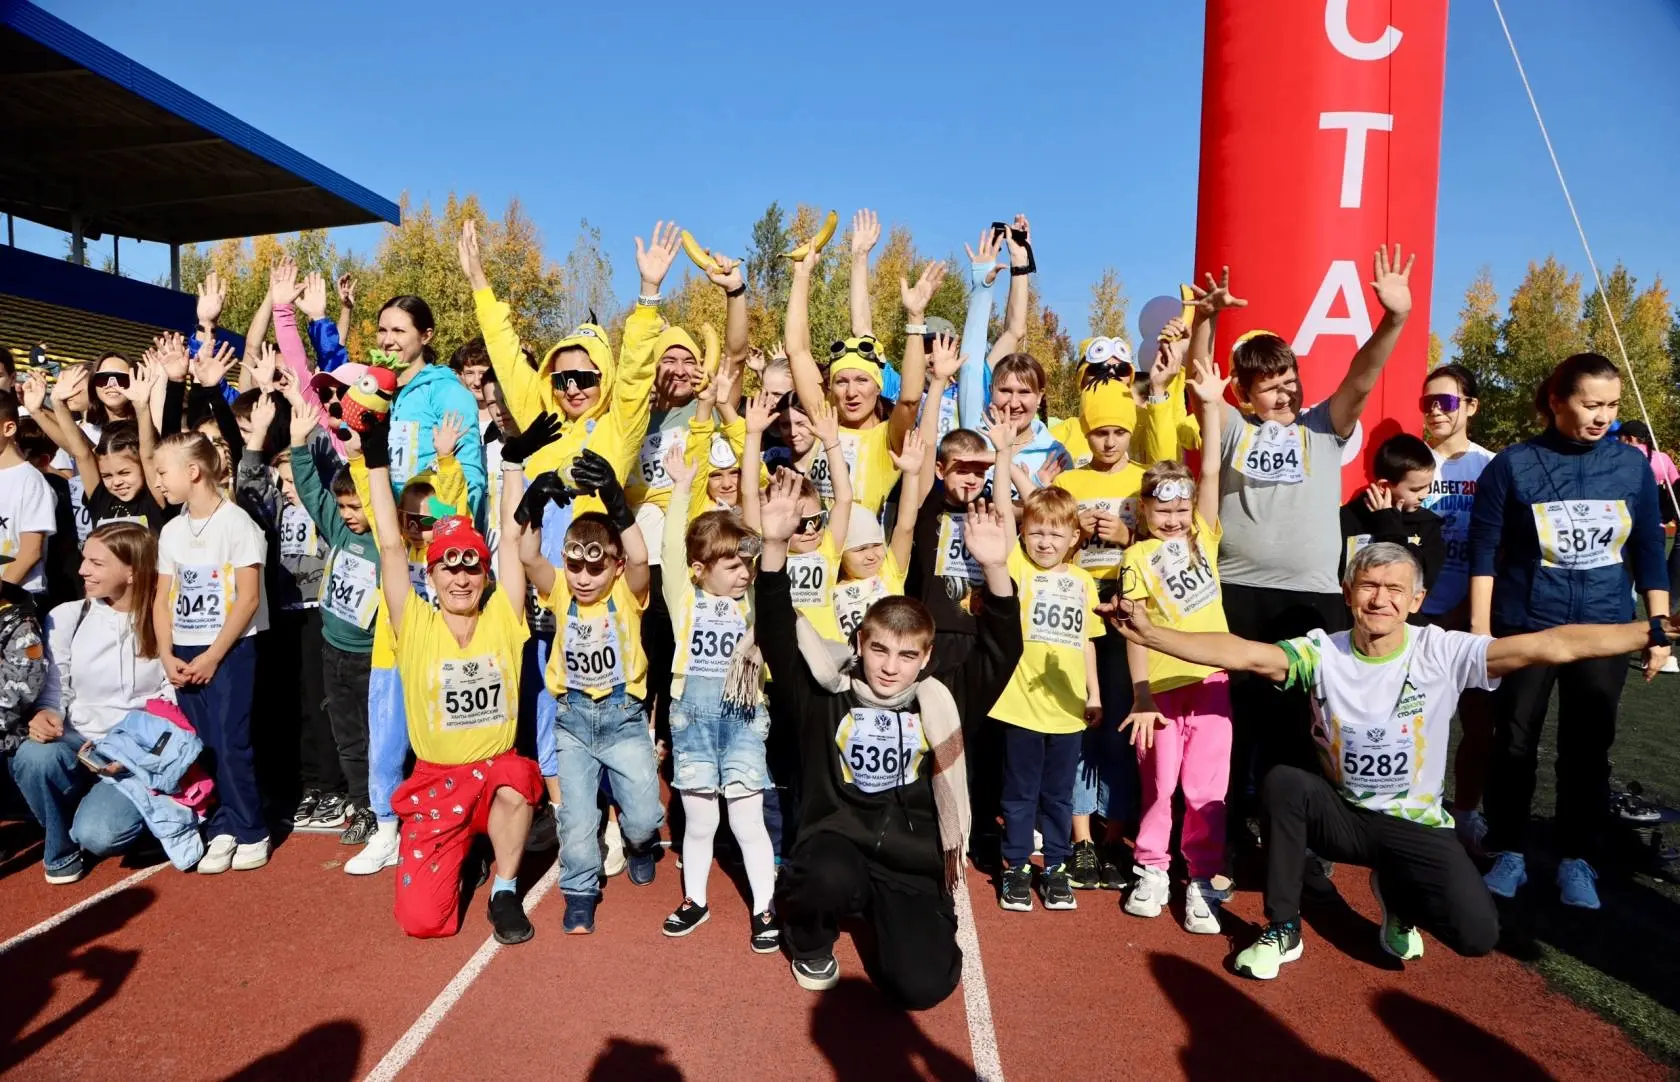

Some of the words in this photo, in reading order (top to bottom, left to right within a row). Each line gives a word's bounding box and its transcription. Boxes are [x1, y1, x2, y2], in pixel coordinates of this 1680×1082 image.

[1291, 0, 1403, 466] СТА
[1246, 448, 1299, 473] 5684
[1557, 526, 1614, 553] 5874
[1166, 556, 1213, 600] 5678
[840, 605, 869, 637] 56
[1032, 602, 1083, 633] 5659
[565, 645, 616, 674] 5300
[445, 683, 501, 714] 5307
[850, 743, 912, 774] 5361
[1343, 751, 1409, 777] 5282
